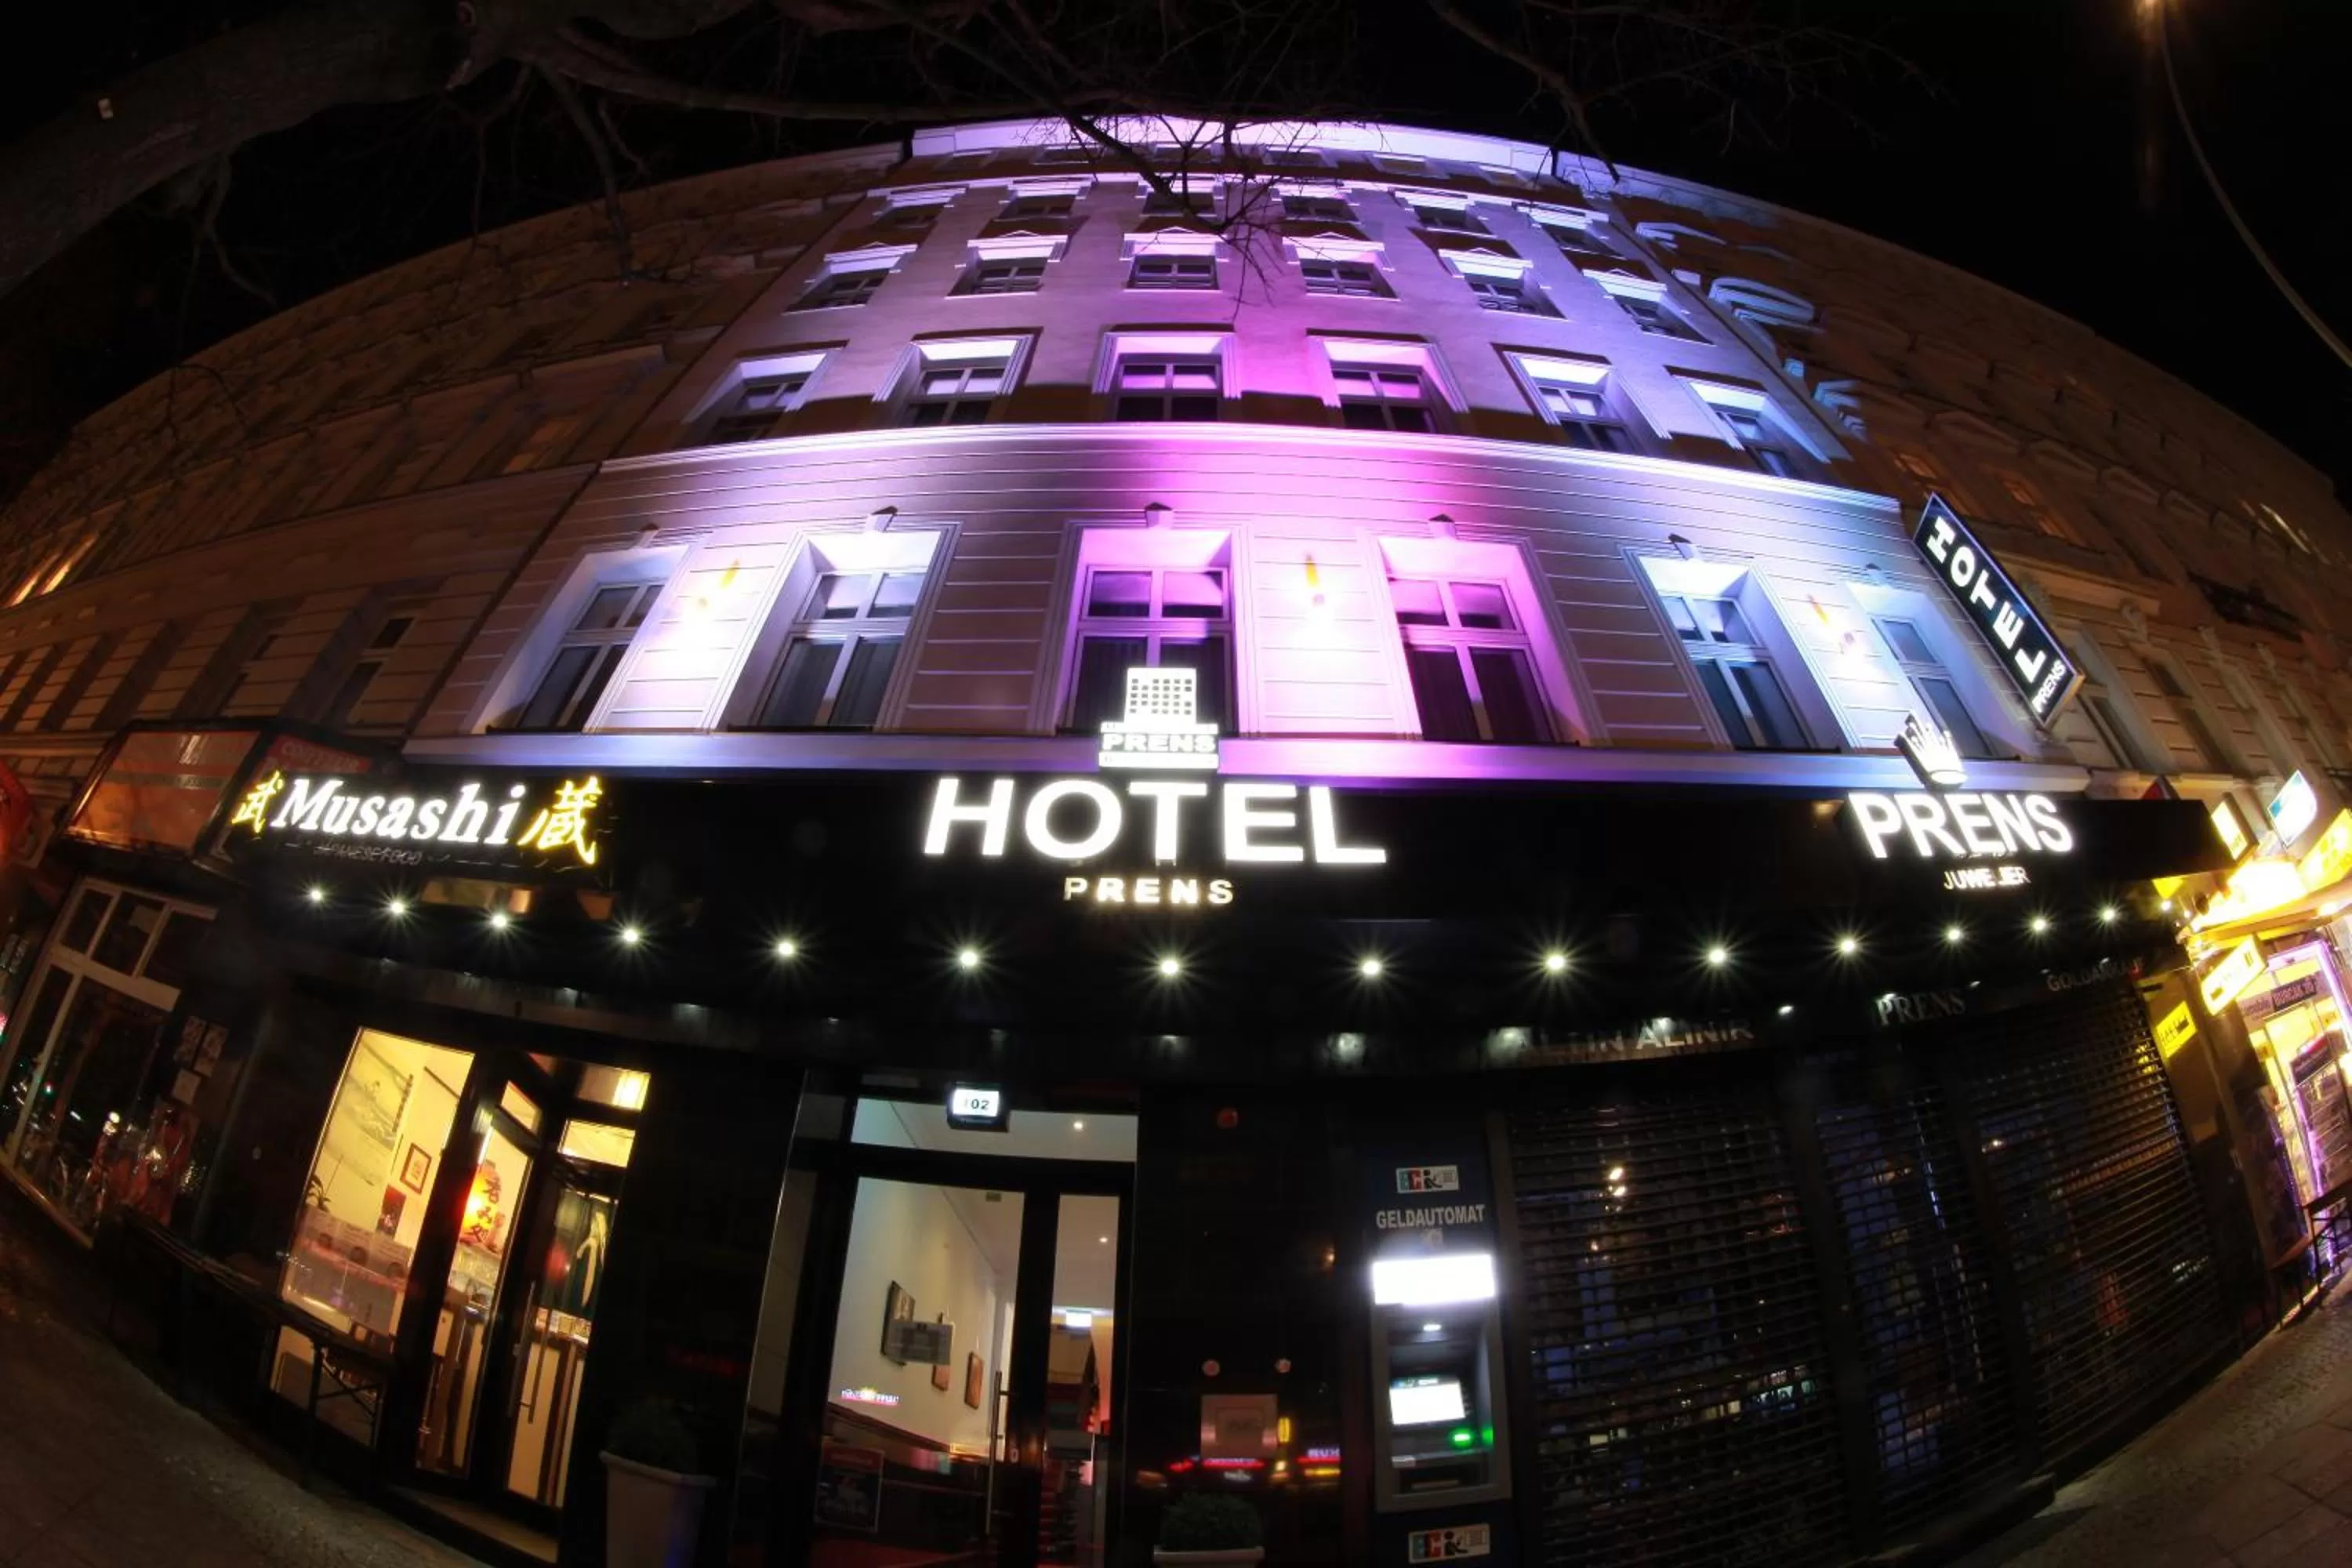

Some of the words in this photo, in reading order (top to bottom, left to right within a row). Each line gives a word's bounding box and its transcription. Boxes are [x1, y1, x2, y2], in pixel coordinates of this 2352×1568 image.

[1926, 517, 2046, 683] HOTEL
[2031, 659, 2067, 713] PRENS
[1102, 734, 1217, 753] PRENS
[270, 778, 526, 845] Musashi
[924, 778, 1386, 862] HOTEL
[1848, 792, 2074, 858] PRENS
[1064, 877, 1234, 905] PRENS
[1874, 987, 1968, 1025] PRENS
[1376, 1203, 1486, 1229] GELDAUTOMAT
